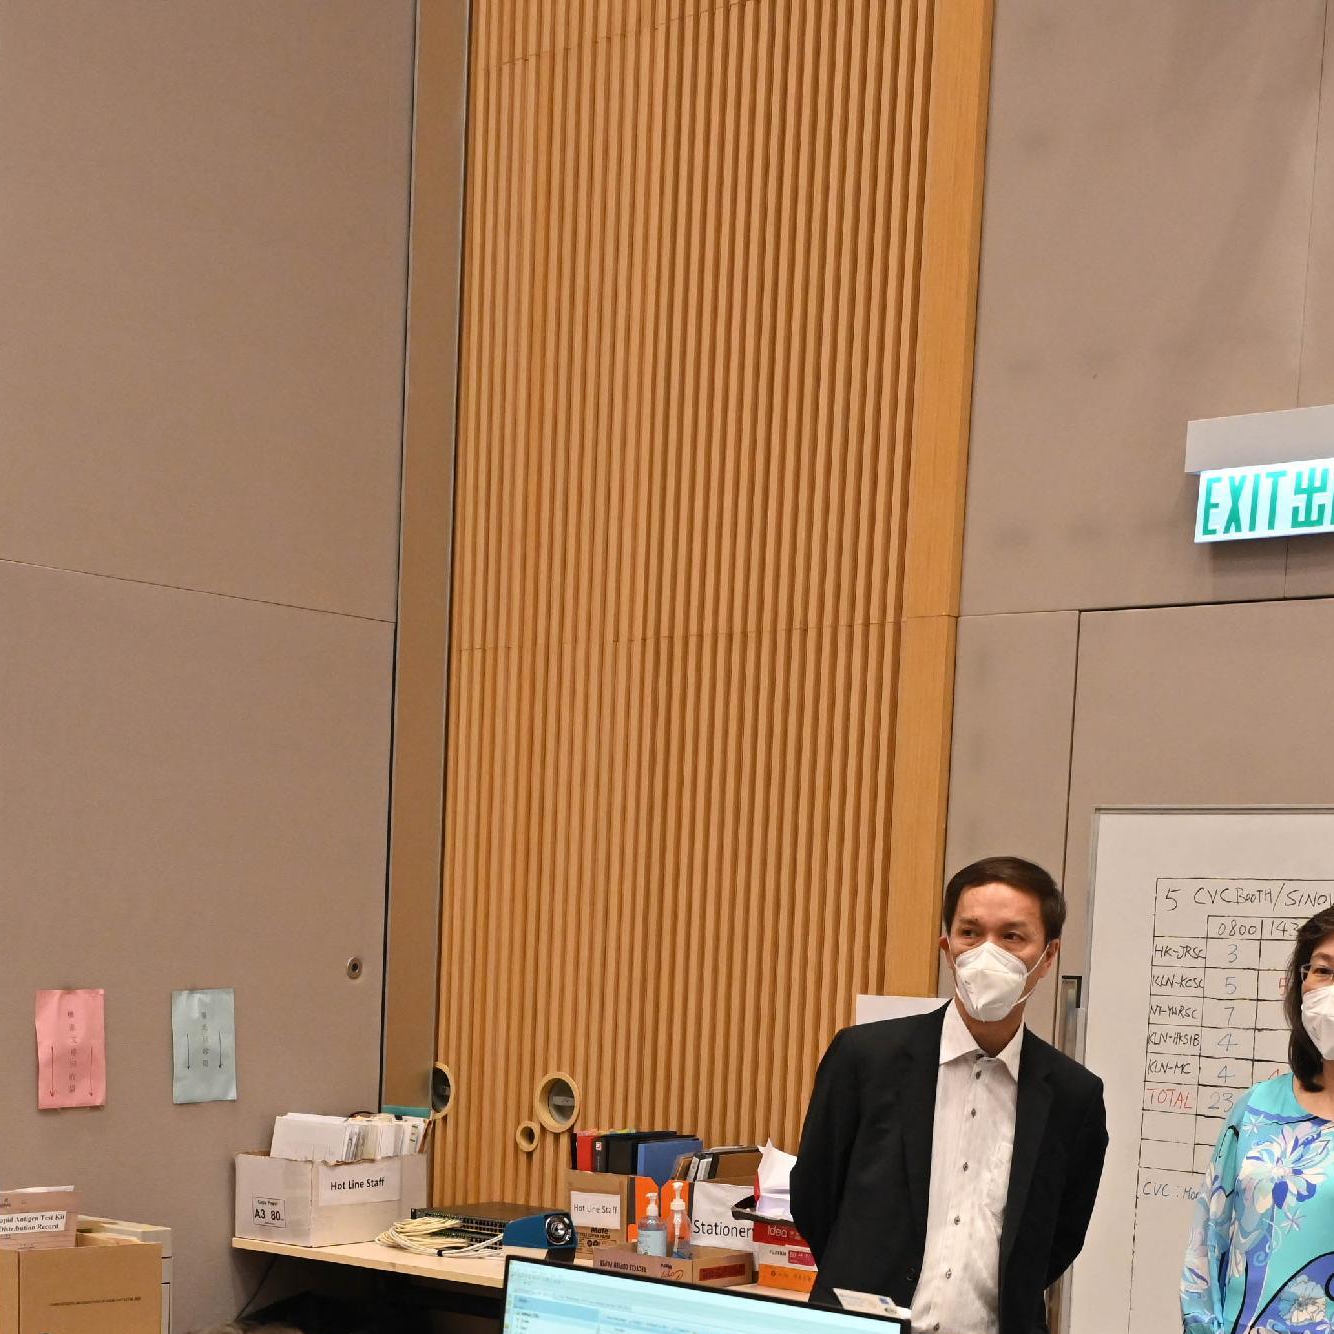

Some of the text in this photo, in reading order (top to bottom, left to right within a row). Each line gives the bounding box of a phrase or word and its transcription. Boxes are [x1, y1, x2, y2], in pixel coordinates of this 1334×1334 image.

[1202, 471, 1287, 535] EXIT
[1165, 888, 1181, 911] 5
[1218, 919, 1301, 937] 0800 143
[1226, 944, 1238, 963] 3
[1225, 976, 1237, 995] 5
[1224, 1007, 1235, 1025] 7
[1217, 1033, 1238, 1052] 4
[1217, 1065, 1235, 1084] 4
[1147, 1088, 1193, 1109] TOTAL
[331, 1177, 385, 1190] Hot Line Staff
[1142, 1182, 1169, 1197] CVC
[254, 1208, 281, 1221] A3 80
[574, 1204, 585, 1213] Hot
[601, 1205, 618, 1214] Staff
[0, 1223, 59, 1232] Distribution Record
[16, 1214, 39, 1224] Antigen
[55, 1213, 65, 1221] Kit
